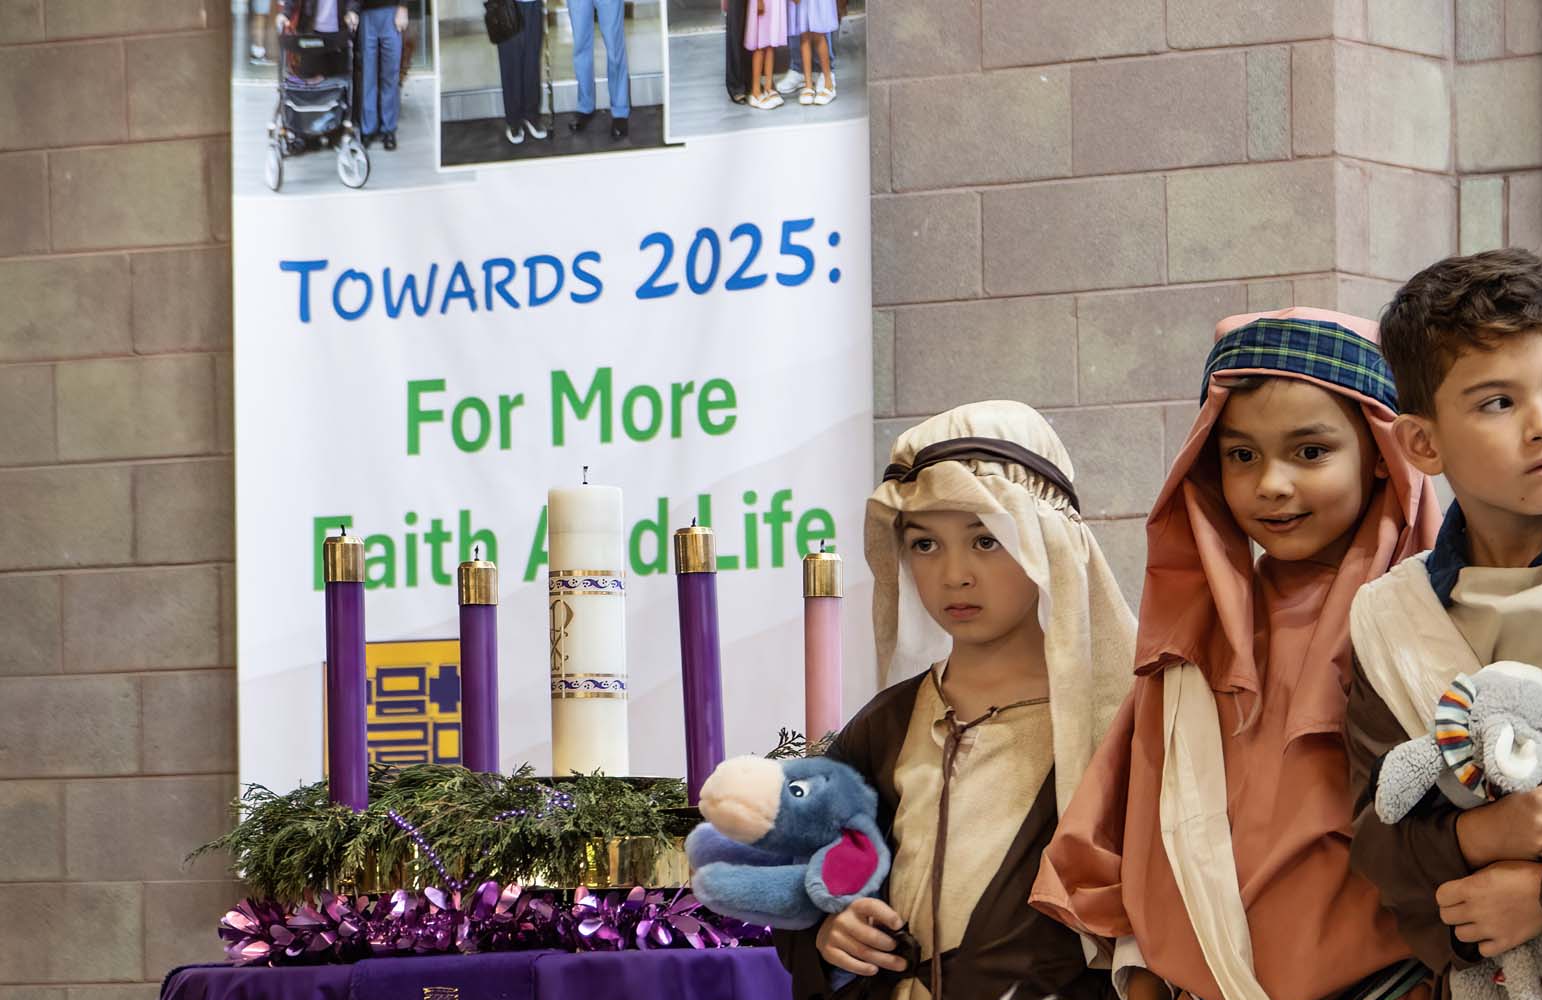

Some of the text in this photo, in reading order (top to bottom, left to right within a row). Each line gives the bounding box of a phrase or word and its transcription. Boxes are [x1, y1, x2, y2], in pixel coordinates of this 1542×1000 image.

[635, 217, 841, 300] 2025:
[406, 366, 738, 456] For More
